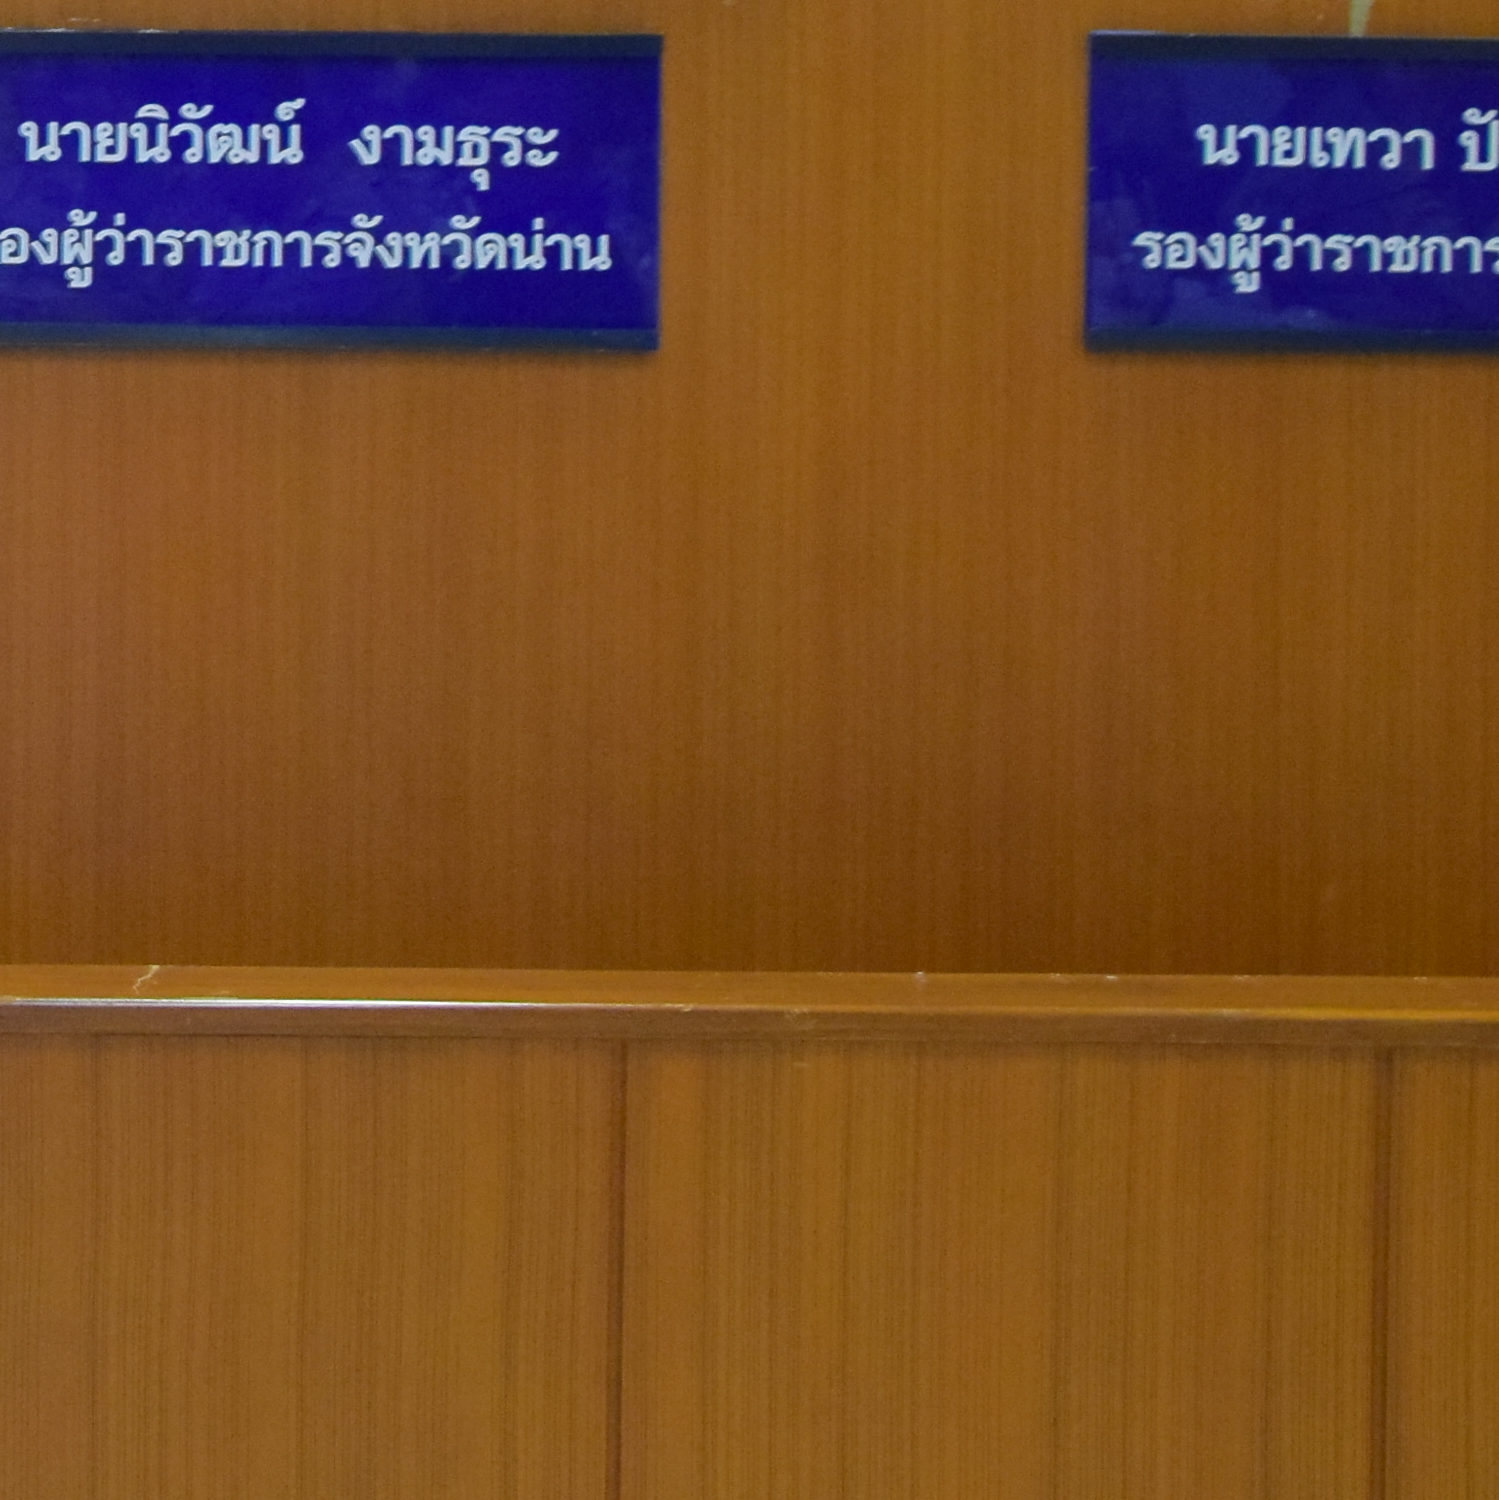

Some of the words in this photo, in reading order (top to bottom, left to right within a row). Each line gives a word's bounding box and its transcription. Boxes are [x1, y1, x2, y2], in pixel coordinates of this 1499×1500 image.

[16, 98, 306, 166] นายนิวัฒน์
[347, 118, 559, 191] งามธุระ
[1195, 122, 1435, 171] นายเทวา
